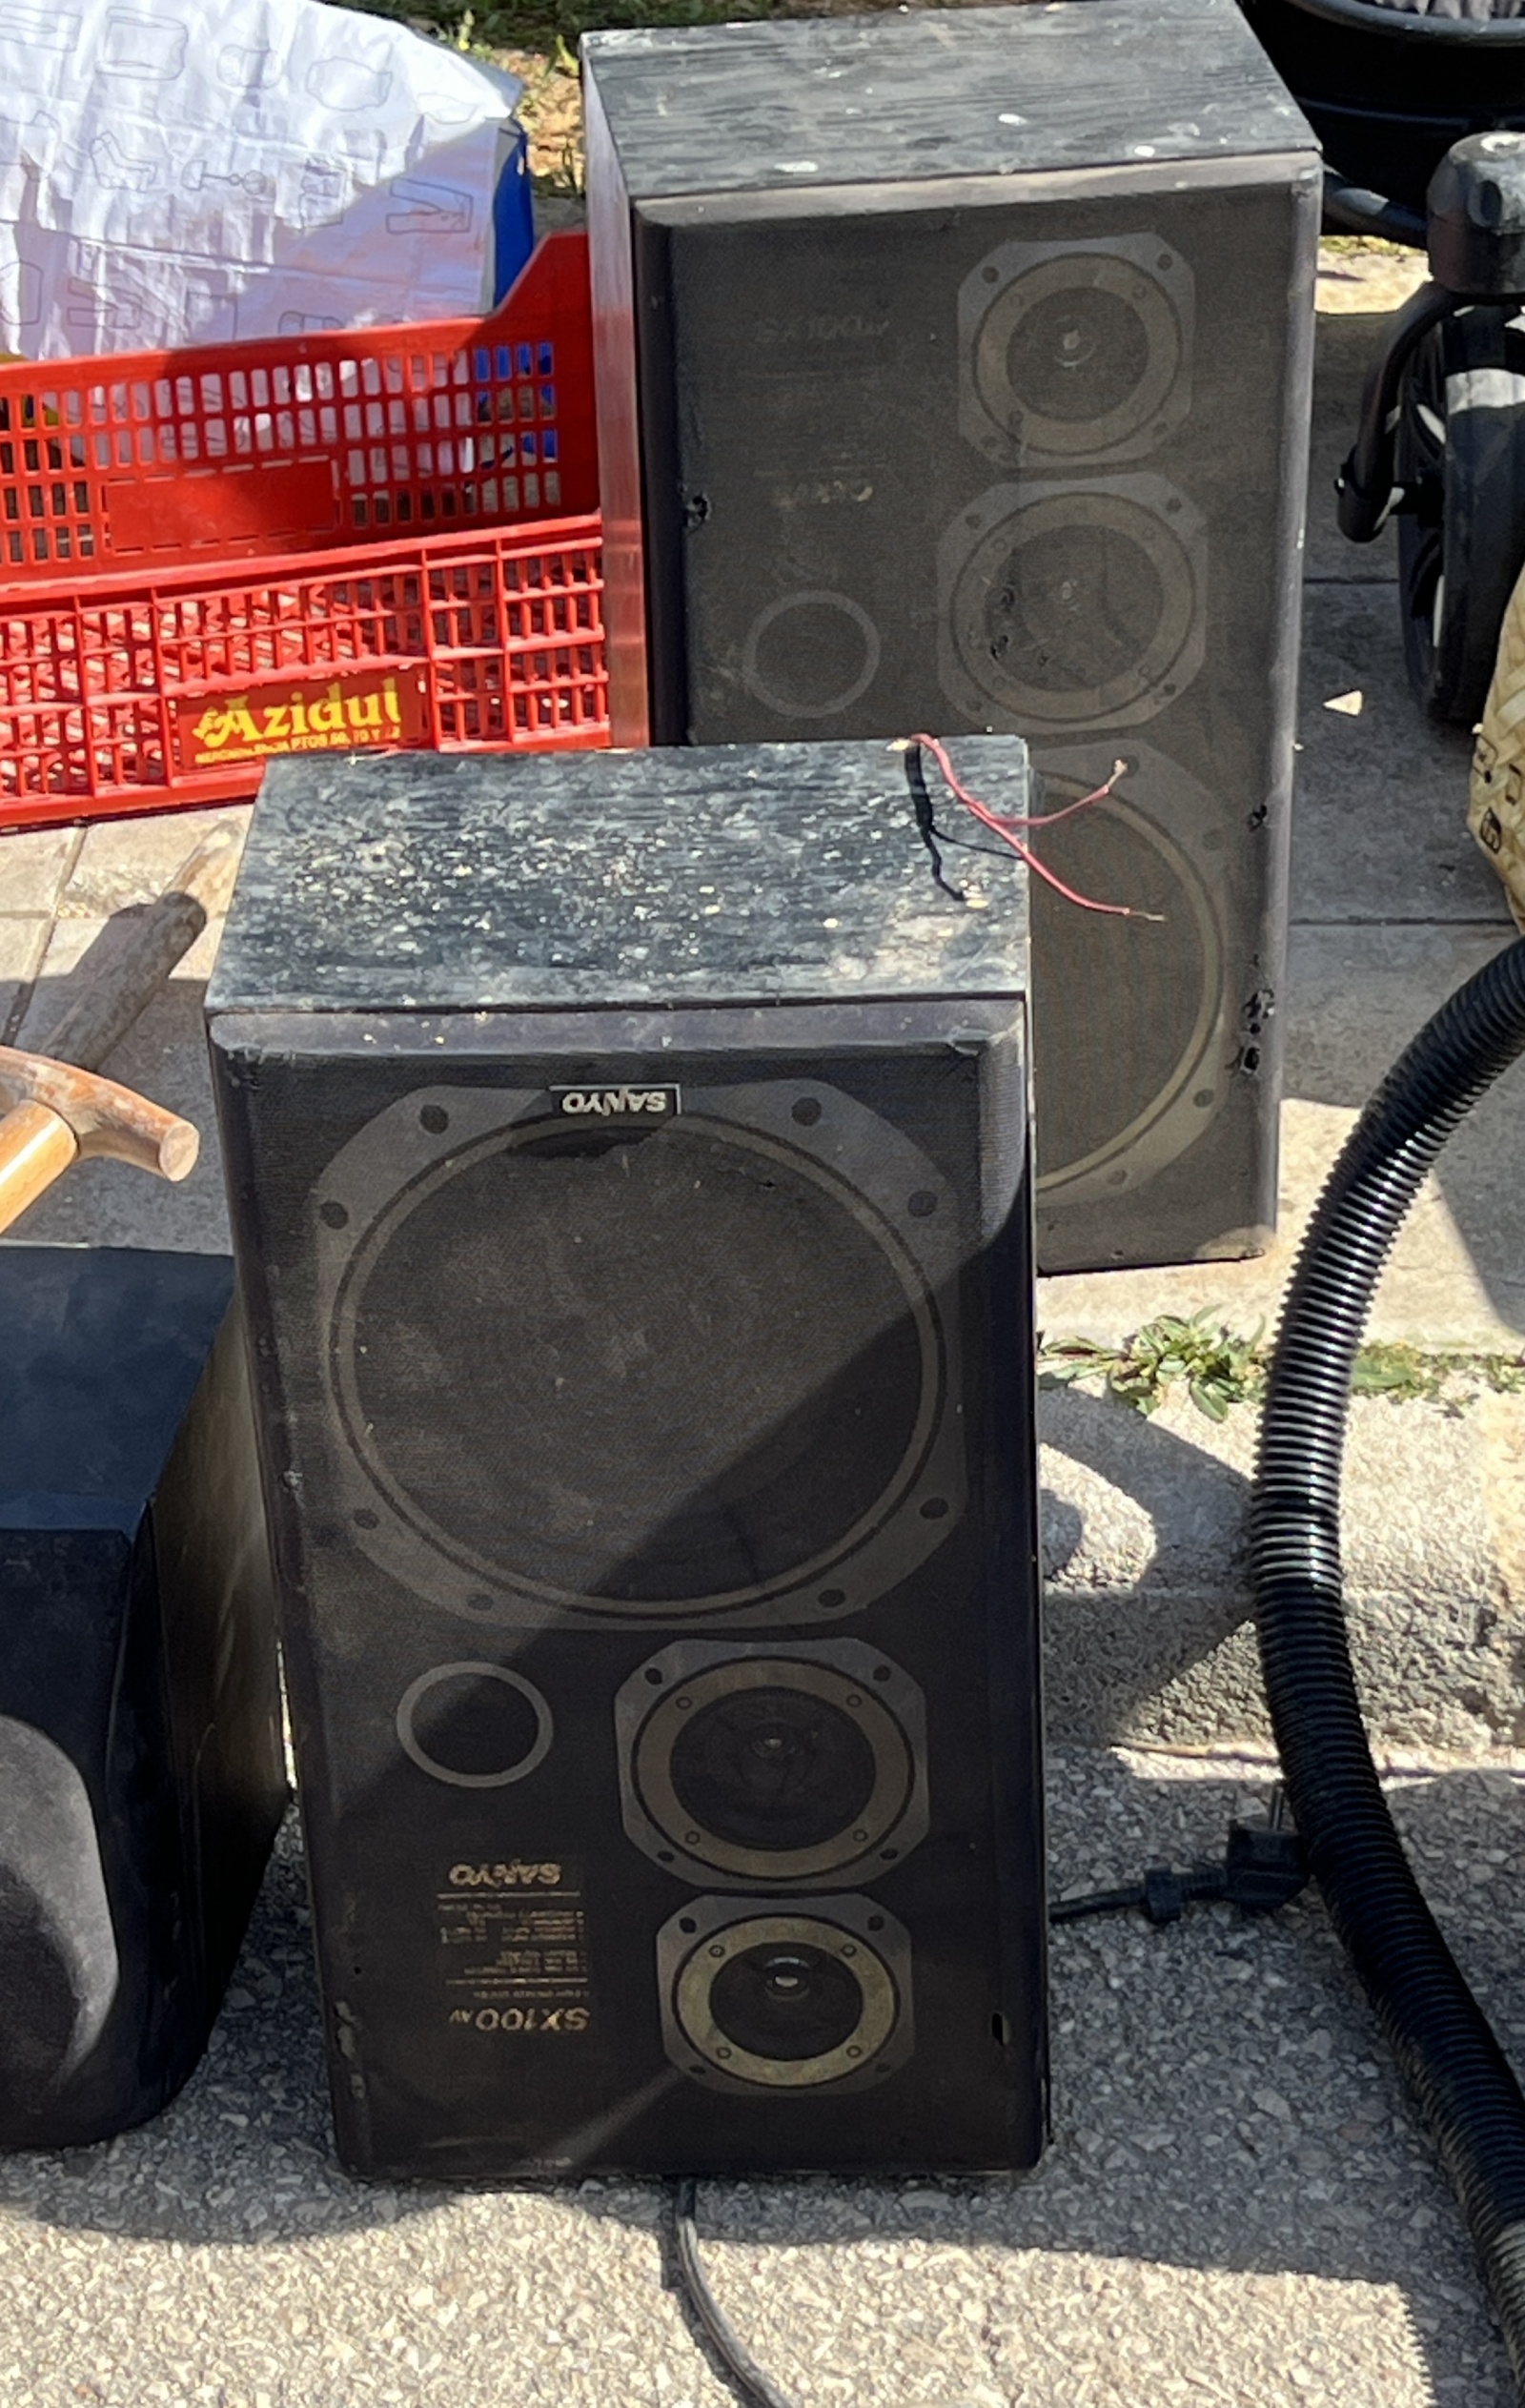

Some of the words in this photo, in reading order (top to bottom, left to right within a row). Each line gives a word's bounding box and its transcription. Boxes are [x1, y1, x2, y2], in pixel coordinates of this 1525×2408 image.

[193, 678, 400, 747] Azidul
[561, 1091, 666, 1116] SANYO
[449, 1860, 561, 1888] SANYO
